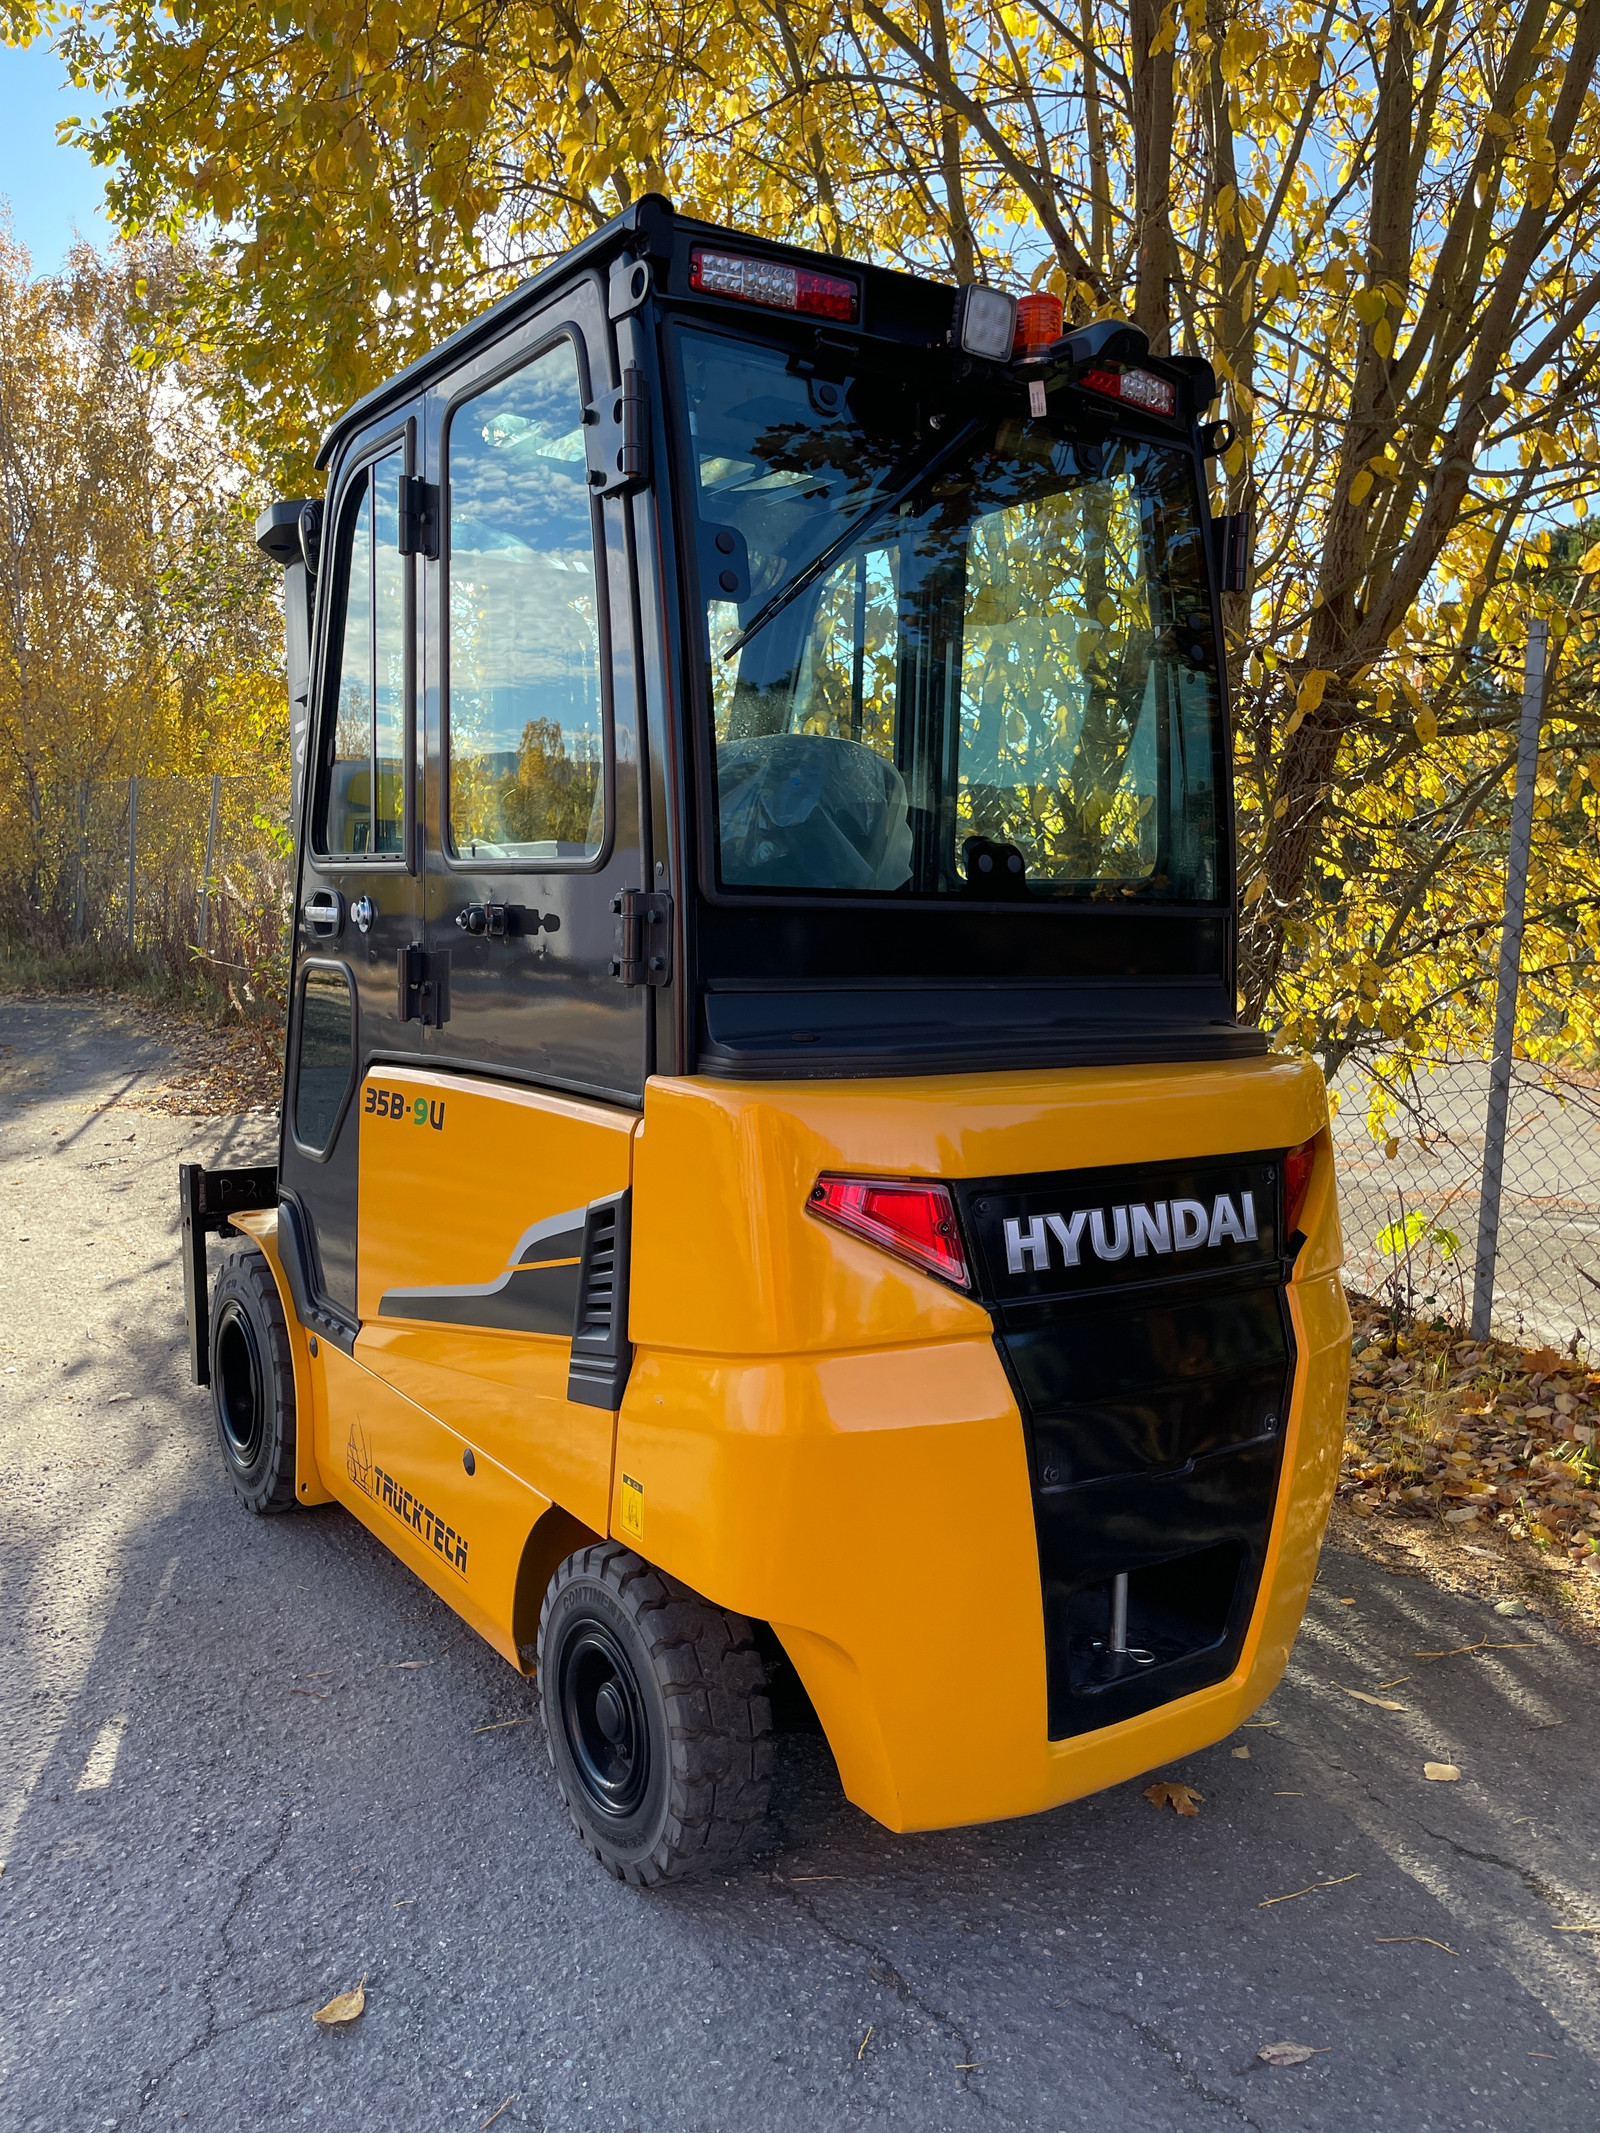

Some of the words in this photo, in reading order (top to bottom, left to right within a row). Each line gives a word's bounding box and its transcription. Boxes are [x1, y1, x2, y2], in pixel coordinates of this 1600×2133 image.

[364, 1087, 445, 1131] 35B-9U
[1002, 1190, 1259, 1275] HYUNDAI
[374, 1465, 468, 1574] TRUCKTECH
